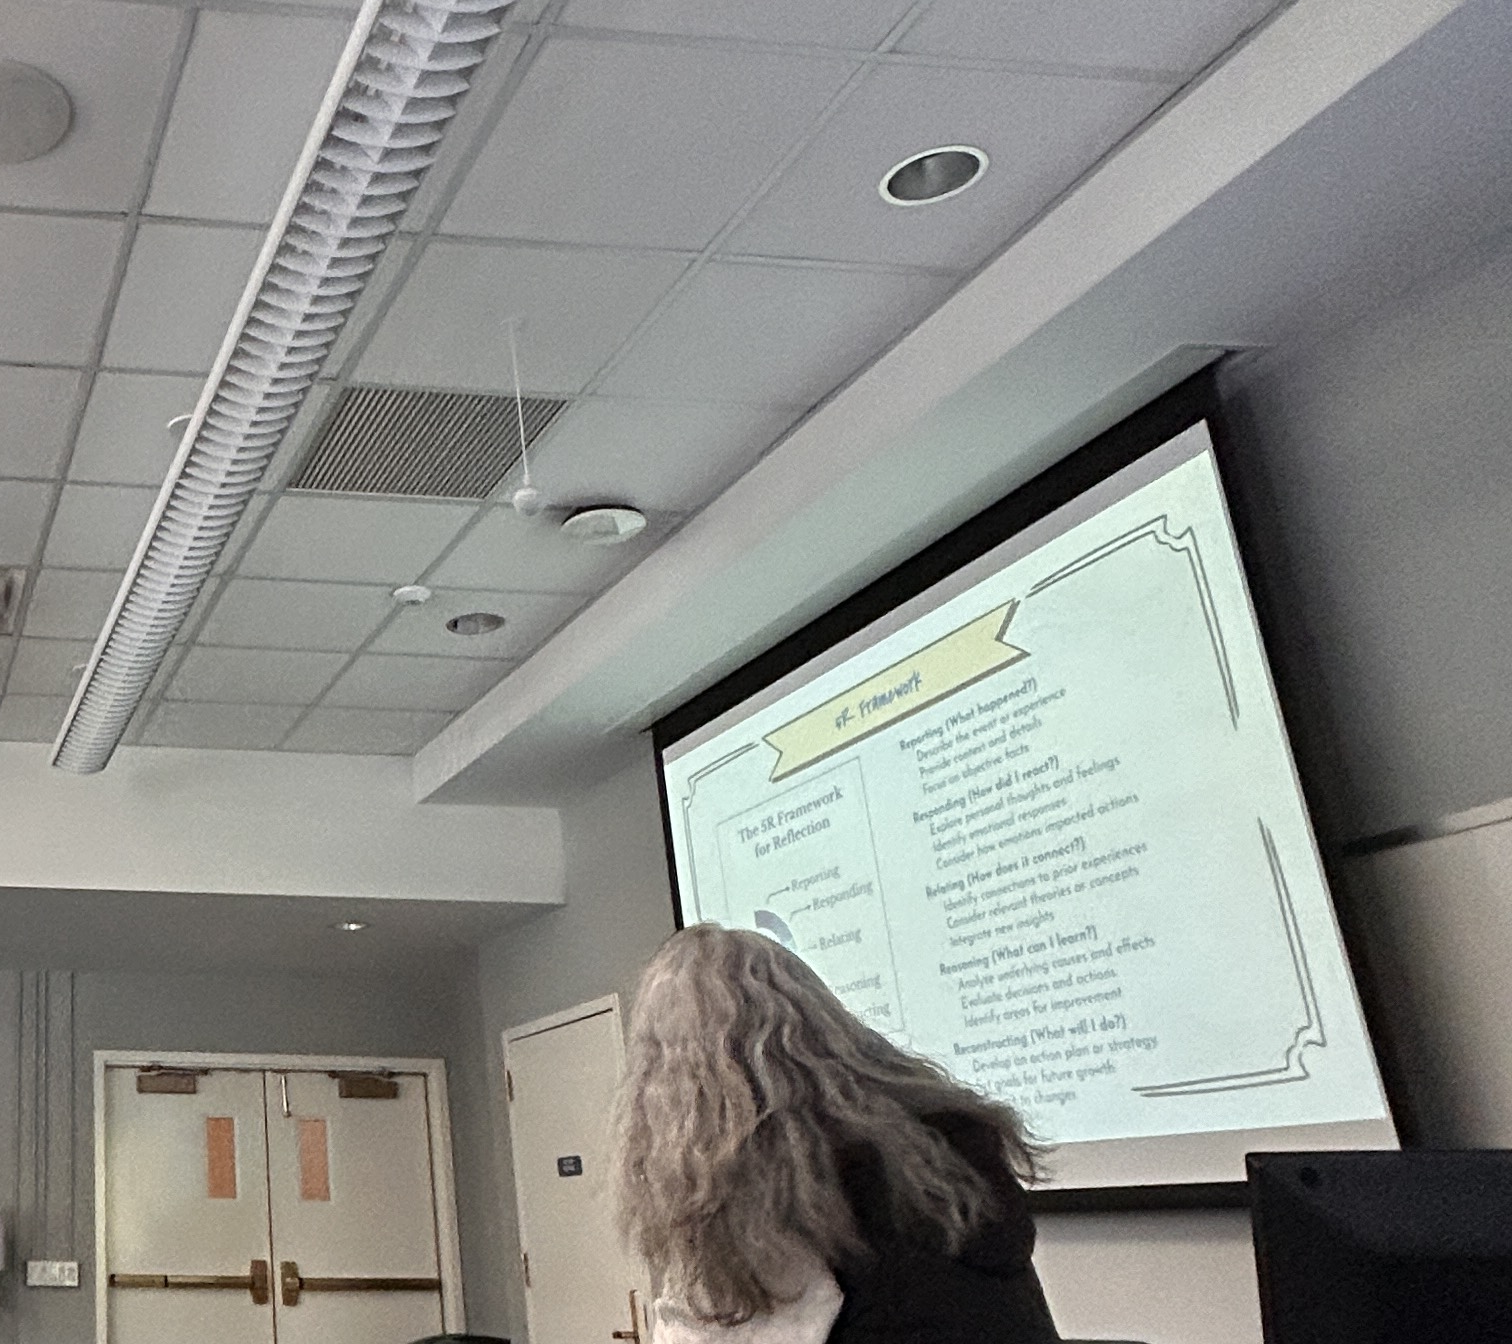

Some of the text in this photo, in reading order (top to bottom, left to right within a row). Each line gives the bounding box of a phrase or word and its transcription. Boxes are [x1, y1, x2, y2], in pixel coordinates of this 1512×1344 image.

[899, 677, 1038, 751] Reporting (What happened?)
[916, 740, 954, 761] Describe
[955, 731, 969, 744] the
[972, 718, 997, 737] event
[1013, 688, 1067, 719] experience
[920, 717, 1042, 777] Provide context and details
[923, 744, 1030, 794] Focus on objective facts
[738, 786, 843, 843] The 5R Framework
[913, 796, 966, 823] Responding
[968, 785, 993, 804] (How
[996, 775, 1013, 791] did
[1022, 756, 1059, 780] react?)
[930, 757, 1120, 835] Explore personal thoughts and feelings
[755, 818, 830, 858] for Reflection
[933, 798, 1067, 852] Identify emotional responses
[936, 793, 1139, 869] Consider how emotions impacted actions
[791, 866, 840, 892] Reporting
[926, 879, 965, 899] Relating
[967, 872, 992, 887] (How
[996, 861, 1019, 876] does
[1032, 836, 1086, 864] connect?)
[944, 843, 1148, 912] Identify connections to prior experiences
[813, 881, 873, 910] Responding
[947, 911, 986, 929] Consider
[989, 896, 1027, 917] relevant
[1030, 885, 1072, 905] theories
[1089, 866, 1139, 889] concepts
[819, 929, 861, 950] Relating
[940, 956, 989, 976] Reasoning
[992, 945, 1023, 964] (What
[1027, 942, 1047, 954] can
[1056, 925, 1097, 946] learn?)
[950, 910, 1054, 947] Integrate new insights
[997, 959, 1048, 982] underlying
[1052, 952, 1087, 968] causes
[1091, 942, 1113, 960] and
[1115, 936, 1156, 955] effects
[962, 967, 1117, 1009] Evaluate decisions and actions
[965, 987, 1121, 1027] Identify areas for improvement
[954, 1034, 1027, 1055] Reconstructing
[1031, 1026, 1065, 1044] (What
[1068, 1019, 1087, 1034] will
[1100, 1014, 1126, 1032] do?)
[973, 1056, 1011, 1072] Develop
[1014, 1054, 1028, 1065] an
[1030, 1051, 1061, 1062] action
[1065, 1045, 1089, 1059] plan
[1109, 1036, 1158, 1051] strategy
[1041, 1067, 1072, 1082] future
[1076, 1059, 1116, 1081] growth
